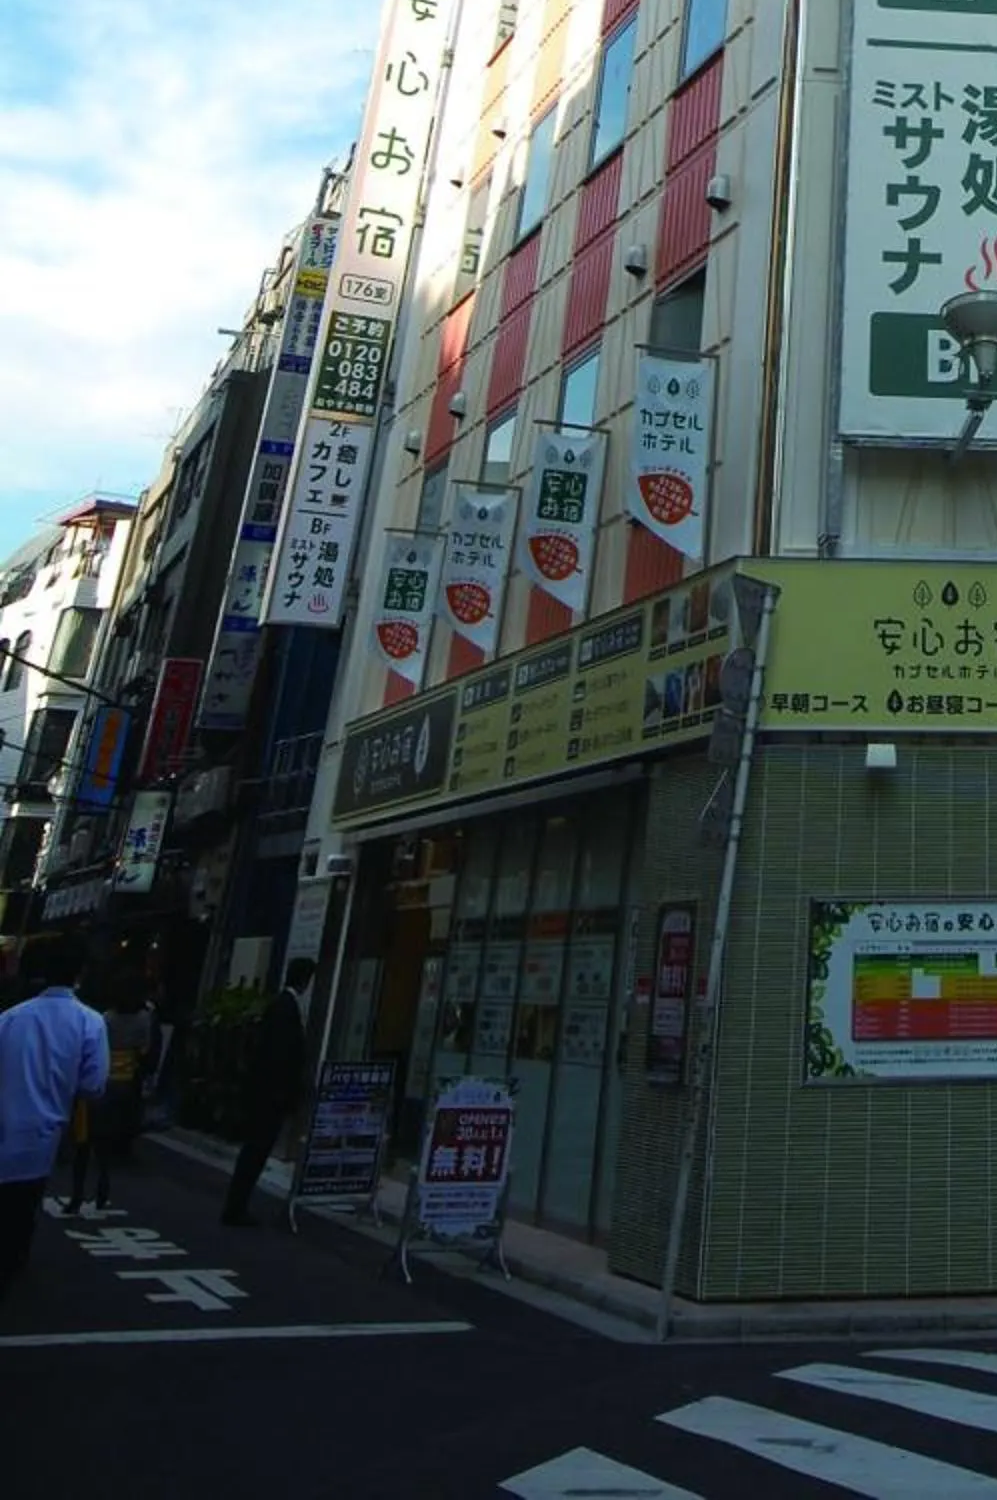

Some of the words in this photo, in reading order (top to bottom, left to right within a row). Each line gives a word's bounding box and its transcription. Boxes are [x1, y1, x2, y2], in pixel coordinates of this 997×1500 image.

[871, 80, 955, 113] ミスト
[881, 116, 944, 295] サウナ
[334, 315, 385, 339] ご予約
[328, 341, 382, 364] 0120
[325, 362, 378, 382] -083
[321, 379, 376, 399] -484
[330, 421, 352, 440] 2F
[640, 408, 704, 431] カプセル
[641, 434, 696, 455] ホテル
[310, 518, 332, 536] BF
[284, 552, 310, 608] サウナ
[770, 693, 869, 714] 早朝コース
